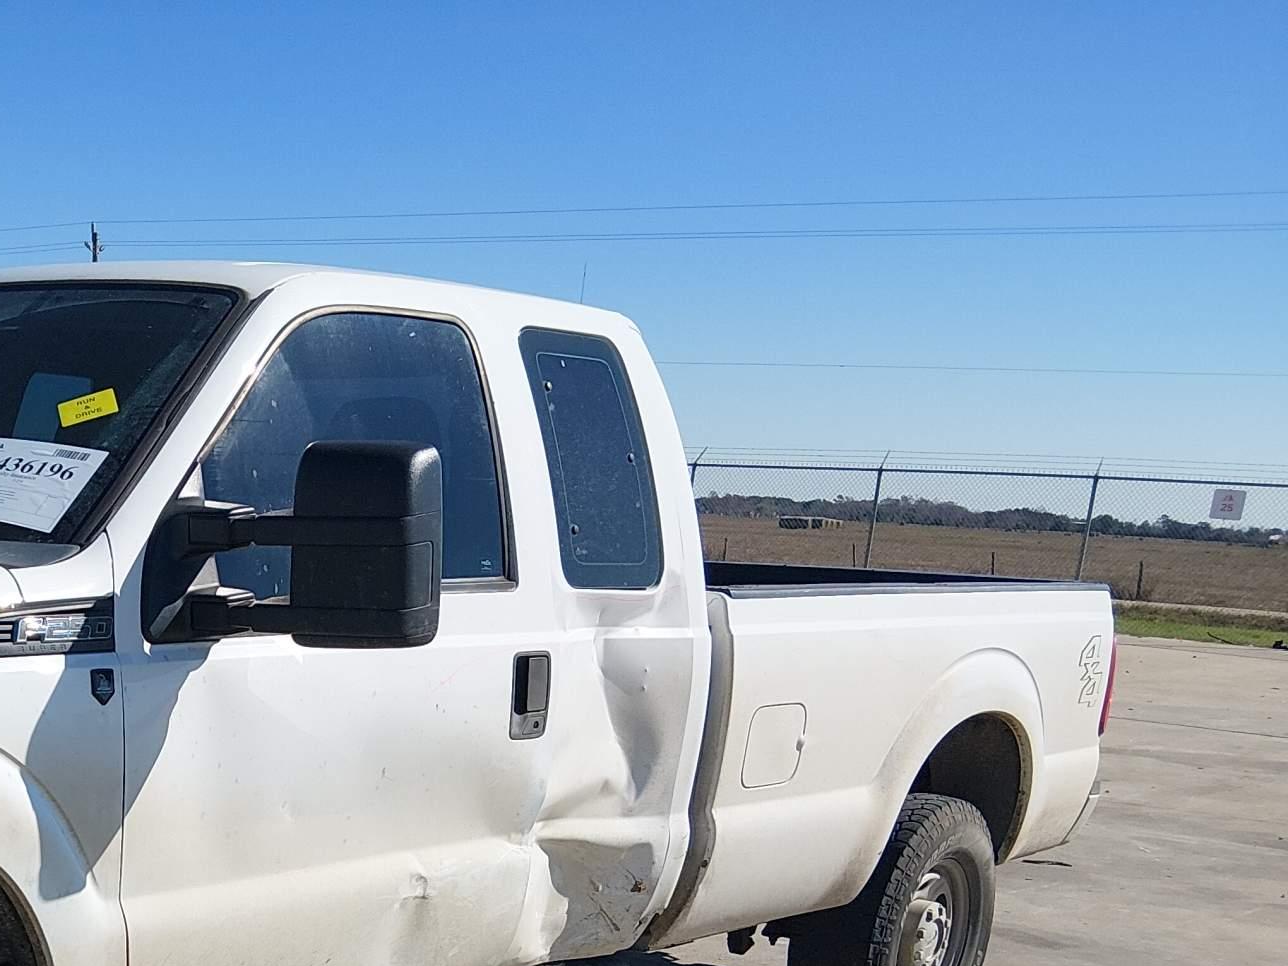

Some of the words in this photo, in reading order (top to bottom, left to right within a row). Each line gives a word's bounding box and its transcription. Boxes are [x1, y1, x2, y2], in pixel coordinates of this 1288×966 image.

[76, 397, 96, 406] RUN
[75, 407, 102, 419] DRIVE
[1220, 503, 1234, 512] 25
